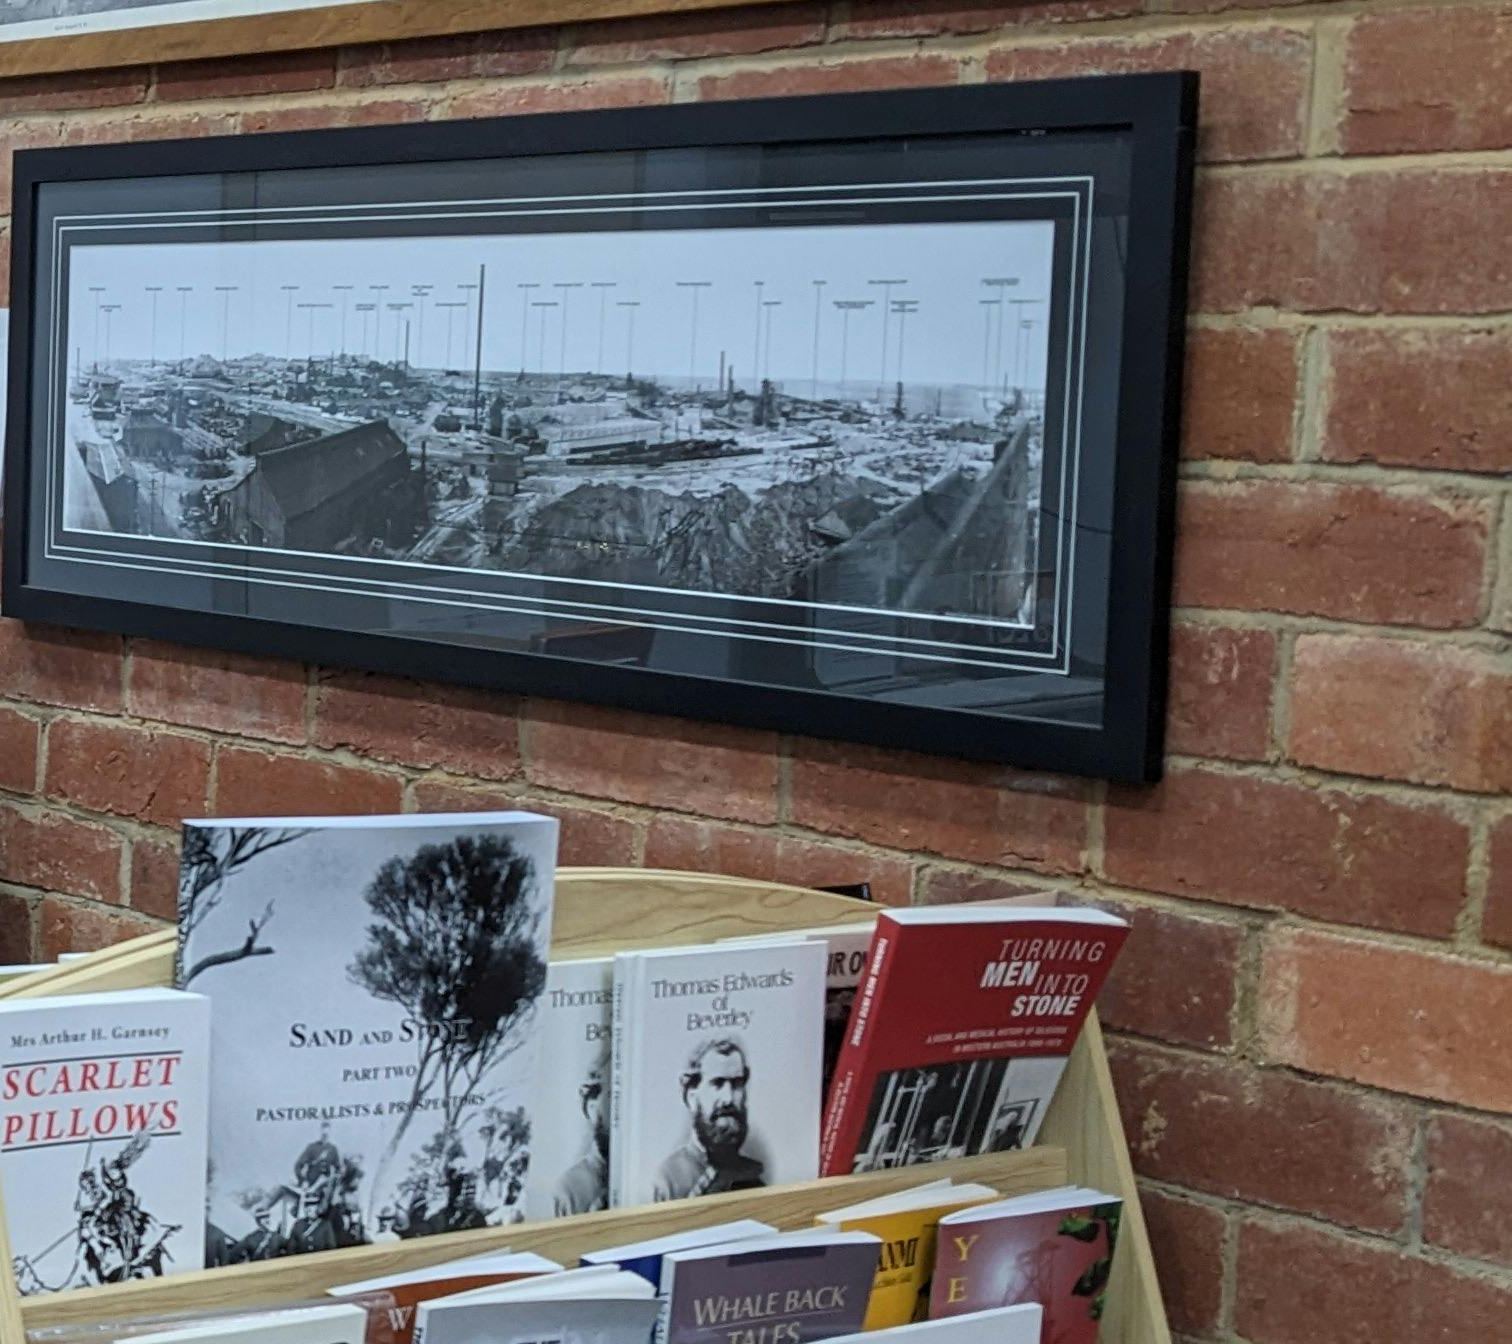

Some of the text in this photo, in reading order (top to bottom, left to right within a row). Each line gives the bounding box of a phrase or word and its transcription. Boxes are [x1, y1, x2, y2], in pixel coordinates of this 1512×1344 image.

[998, 939, 1106, 962] TURNING
[651, 970, 794, 999] Thomas Edwards
[980, 961, 1088, 995] MEN INTO
[712, 994, 728, 1010] of
[1010, 994, 1082, 1018] STONE
[686, 1008, 755, 1031] Beverley
[11, 1023, 170, 1050] Mrs Arthur H. Garnsey
[289, 1022, 353, 1048] SAND
[360, 1030, 393, 1045] AND
[3, 1056, 182, 1101] SCARLET
[343, 1064, 417, 1082] PART TWO
[3, 1100, 180, 1146] PILLOWS
[694, 1286, 847, 1326] WHALE BACK
